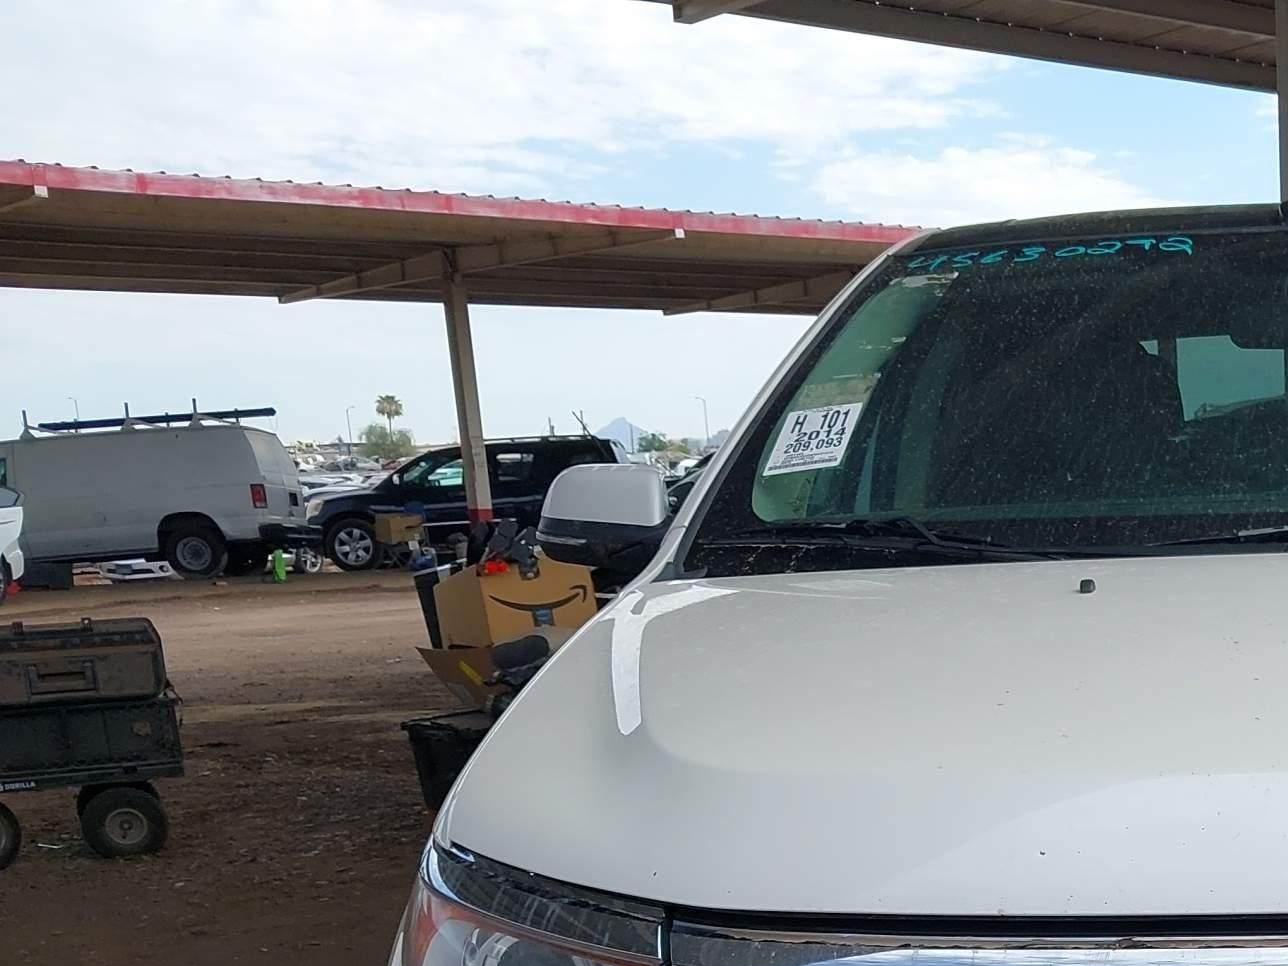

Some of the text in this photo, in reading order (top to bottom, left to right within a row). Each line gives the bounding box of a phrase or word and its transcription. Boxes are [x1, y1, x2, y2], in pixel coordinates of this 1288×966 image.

[791, 408, 851, 433] H 101
[794, 427, 846, 442] 2014
